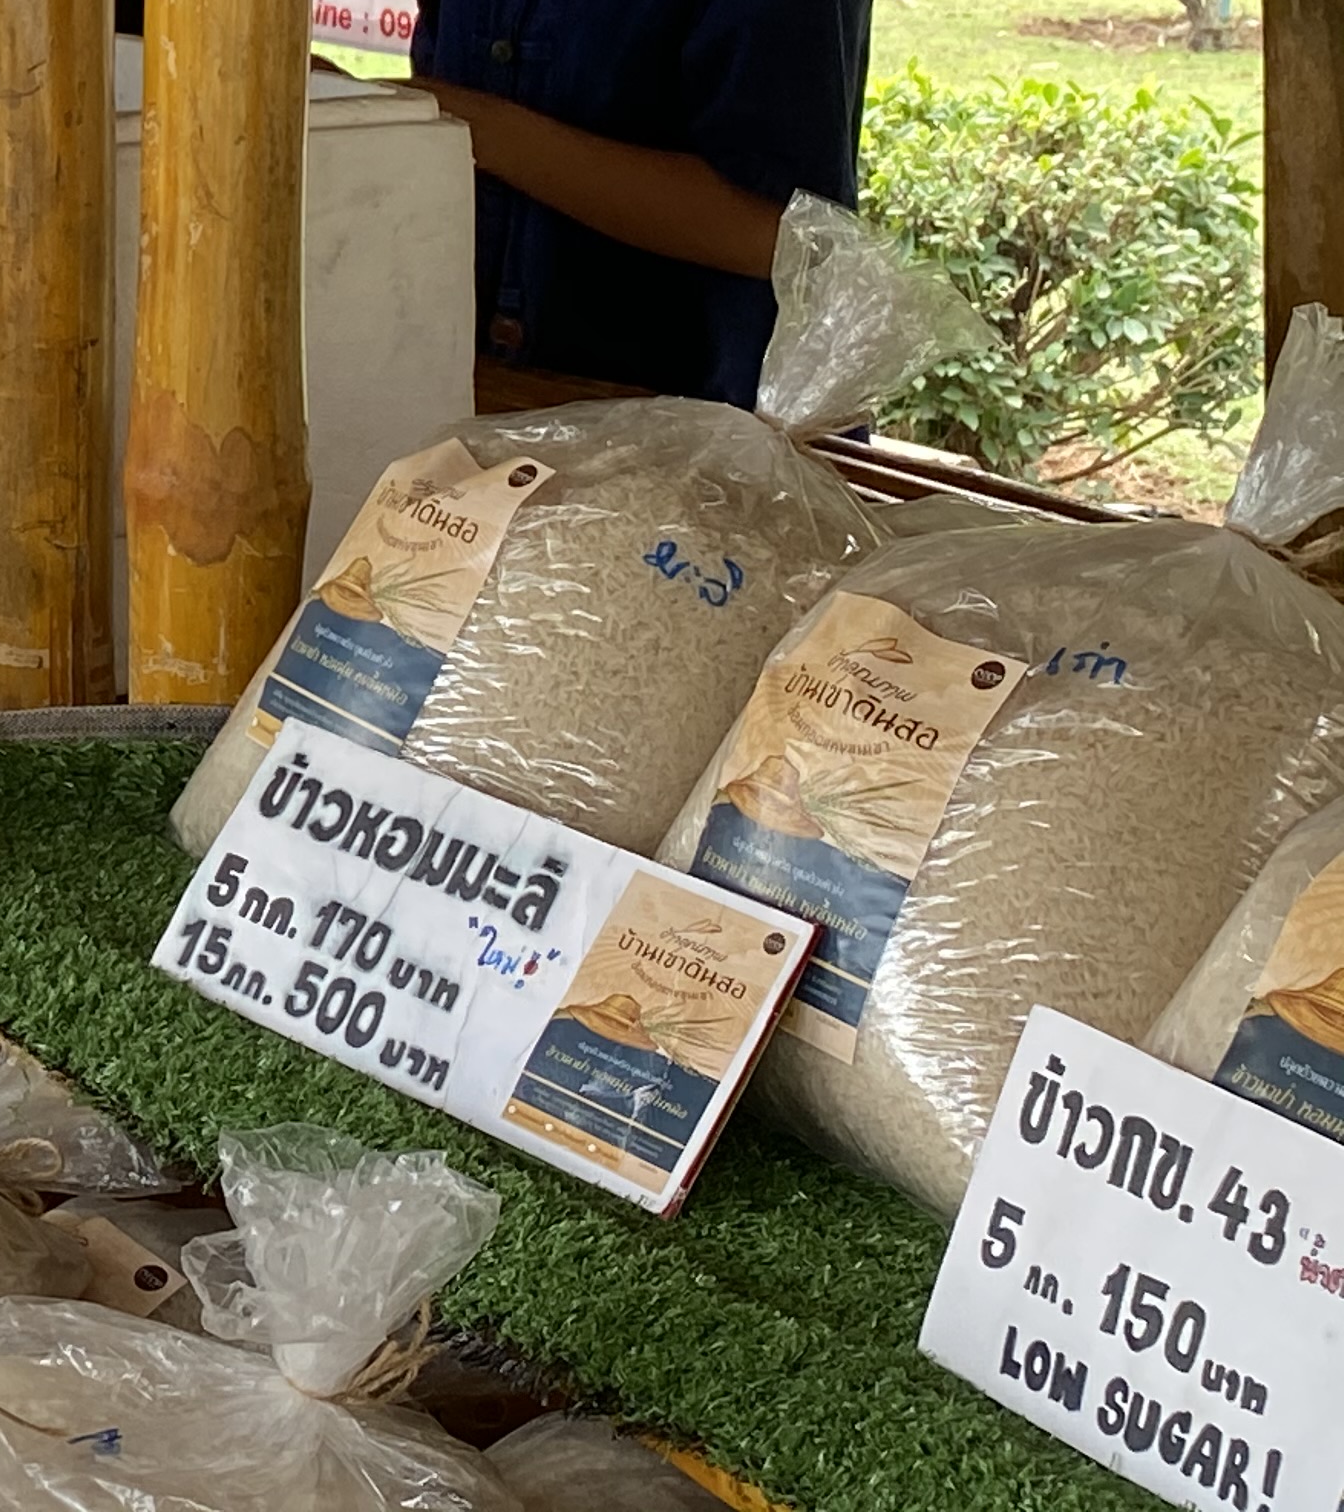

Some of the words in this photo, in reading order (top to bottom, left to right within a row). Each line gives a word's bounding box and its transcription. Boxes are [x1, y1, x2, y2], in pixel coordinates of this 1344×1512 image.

[784, 663, 940, 752] บ้านเขาดินสอ
[257, 752, 565, 933] ข้าวหอมมะลิ
[176, 918, 230, 977] 15
[225, 959, 274, 1008] กก.
[285, 960, 385, 1050] 500
[379, 1031, 450, 1092] บาท
[206, 852, 246, 909] 5
[238, 886, 299, 941] กก.
[310, 899, 384, 972] 170
[388, 954, 463, 1014] บาท
[618, 928, 748, 1001] บ้านเขาดินสอ
[1018, 1054, 1195, 1224] ข้าวกข.
[1208, 1165, 1291, 1267] 43
[981, 1197, 1026, 1271] 5
[1023, 1264, 1074, 1316] กก.
[1100, 1263, 1207, 1376] 150
[1200, 1359, 1270, 1417] บาท
[999, 1325, 1089, 1412] LOW
